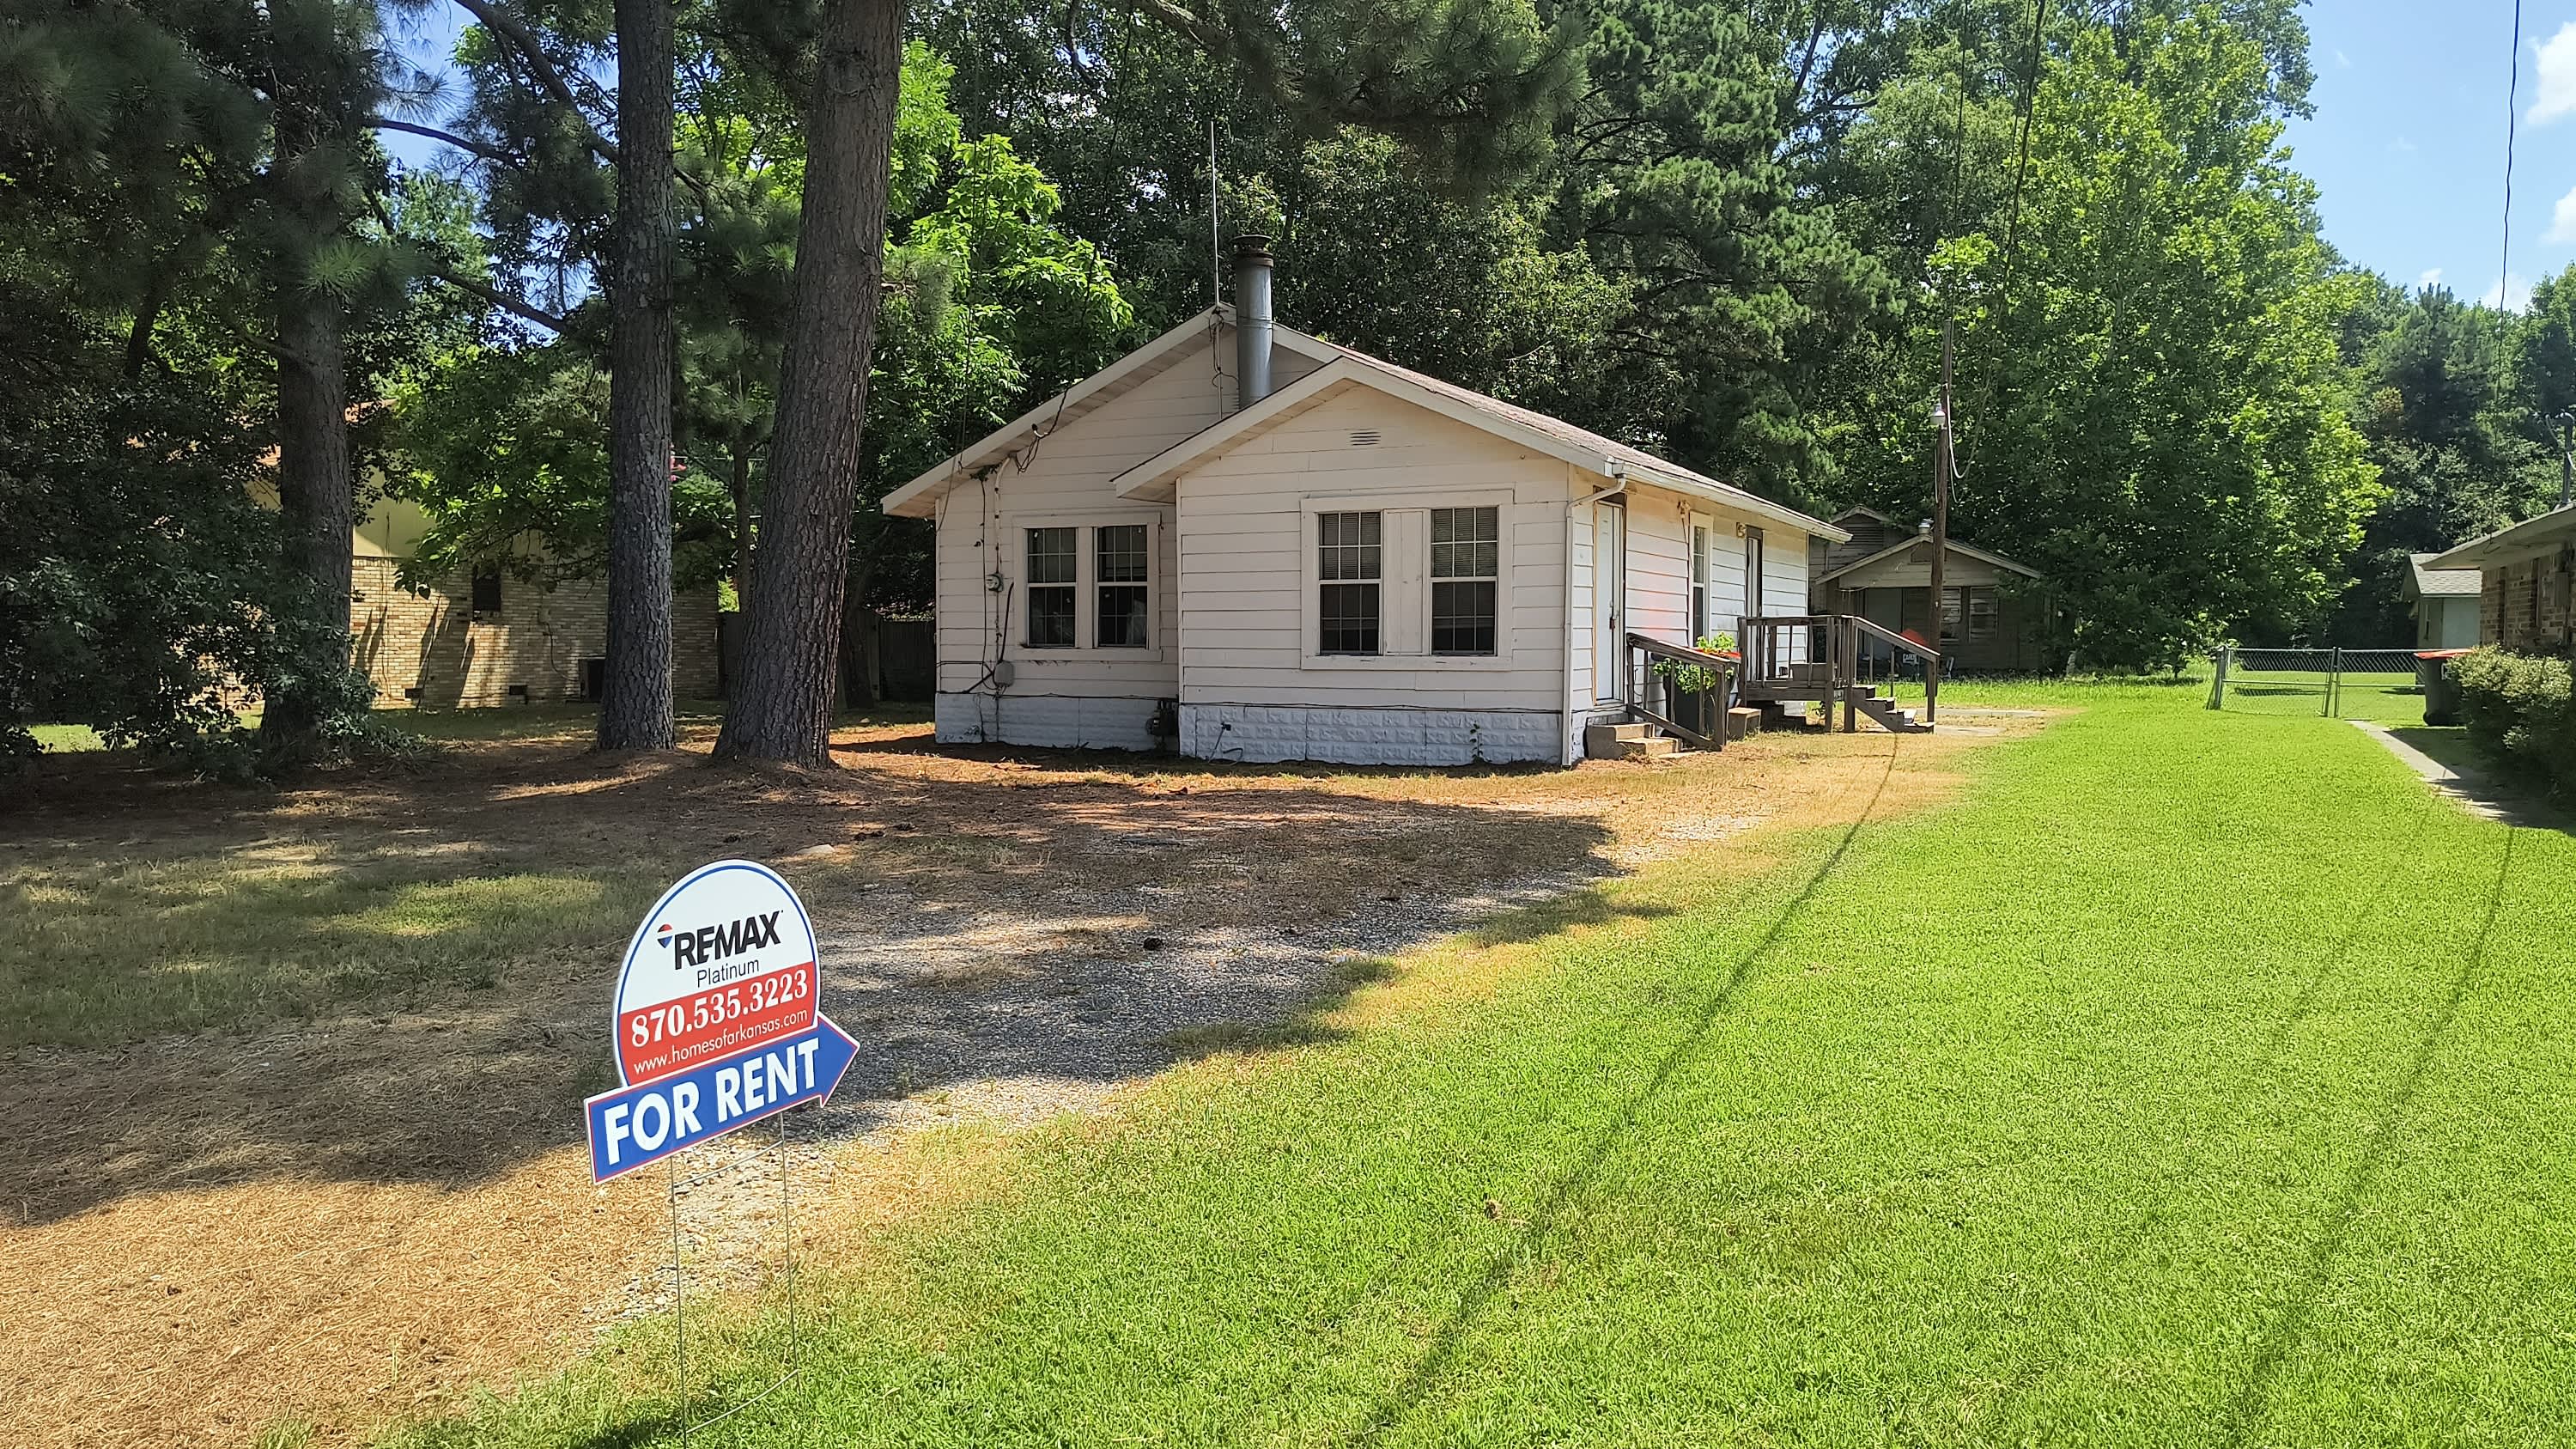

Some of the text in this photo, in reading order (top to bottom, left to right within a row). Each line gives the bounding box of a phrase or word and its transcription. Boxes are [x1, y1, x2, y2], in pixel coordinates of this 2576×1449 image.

[675, 910, 781, 970] REMAX
[697, 959, 759, 988] Platinum
[631, 969, 808, 1048] 870.535.3223
[634, 1009, 807, 1074] www.homesofarkansas.com
[604, 1037, 819, 1165] FOR RENT
